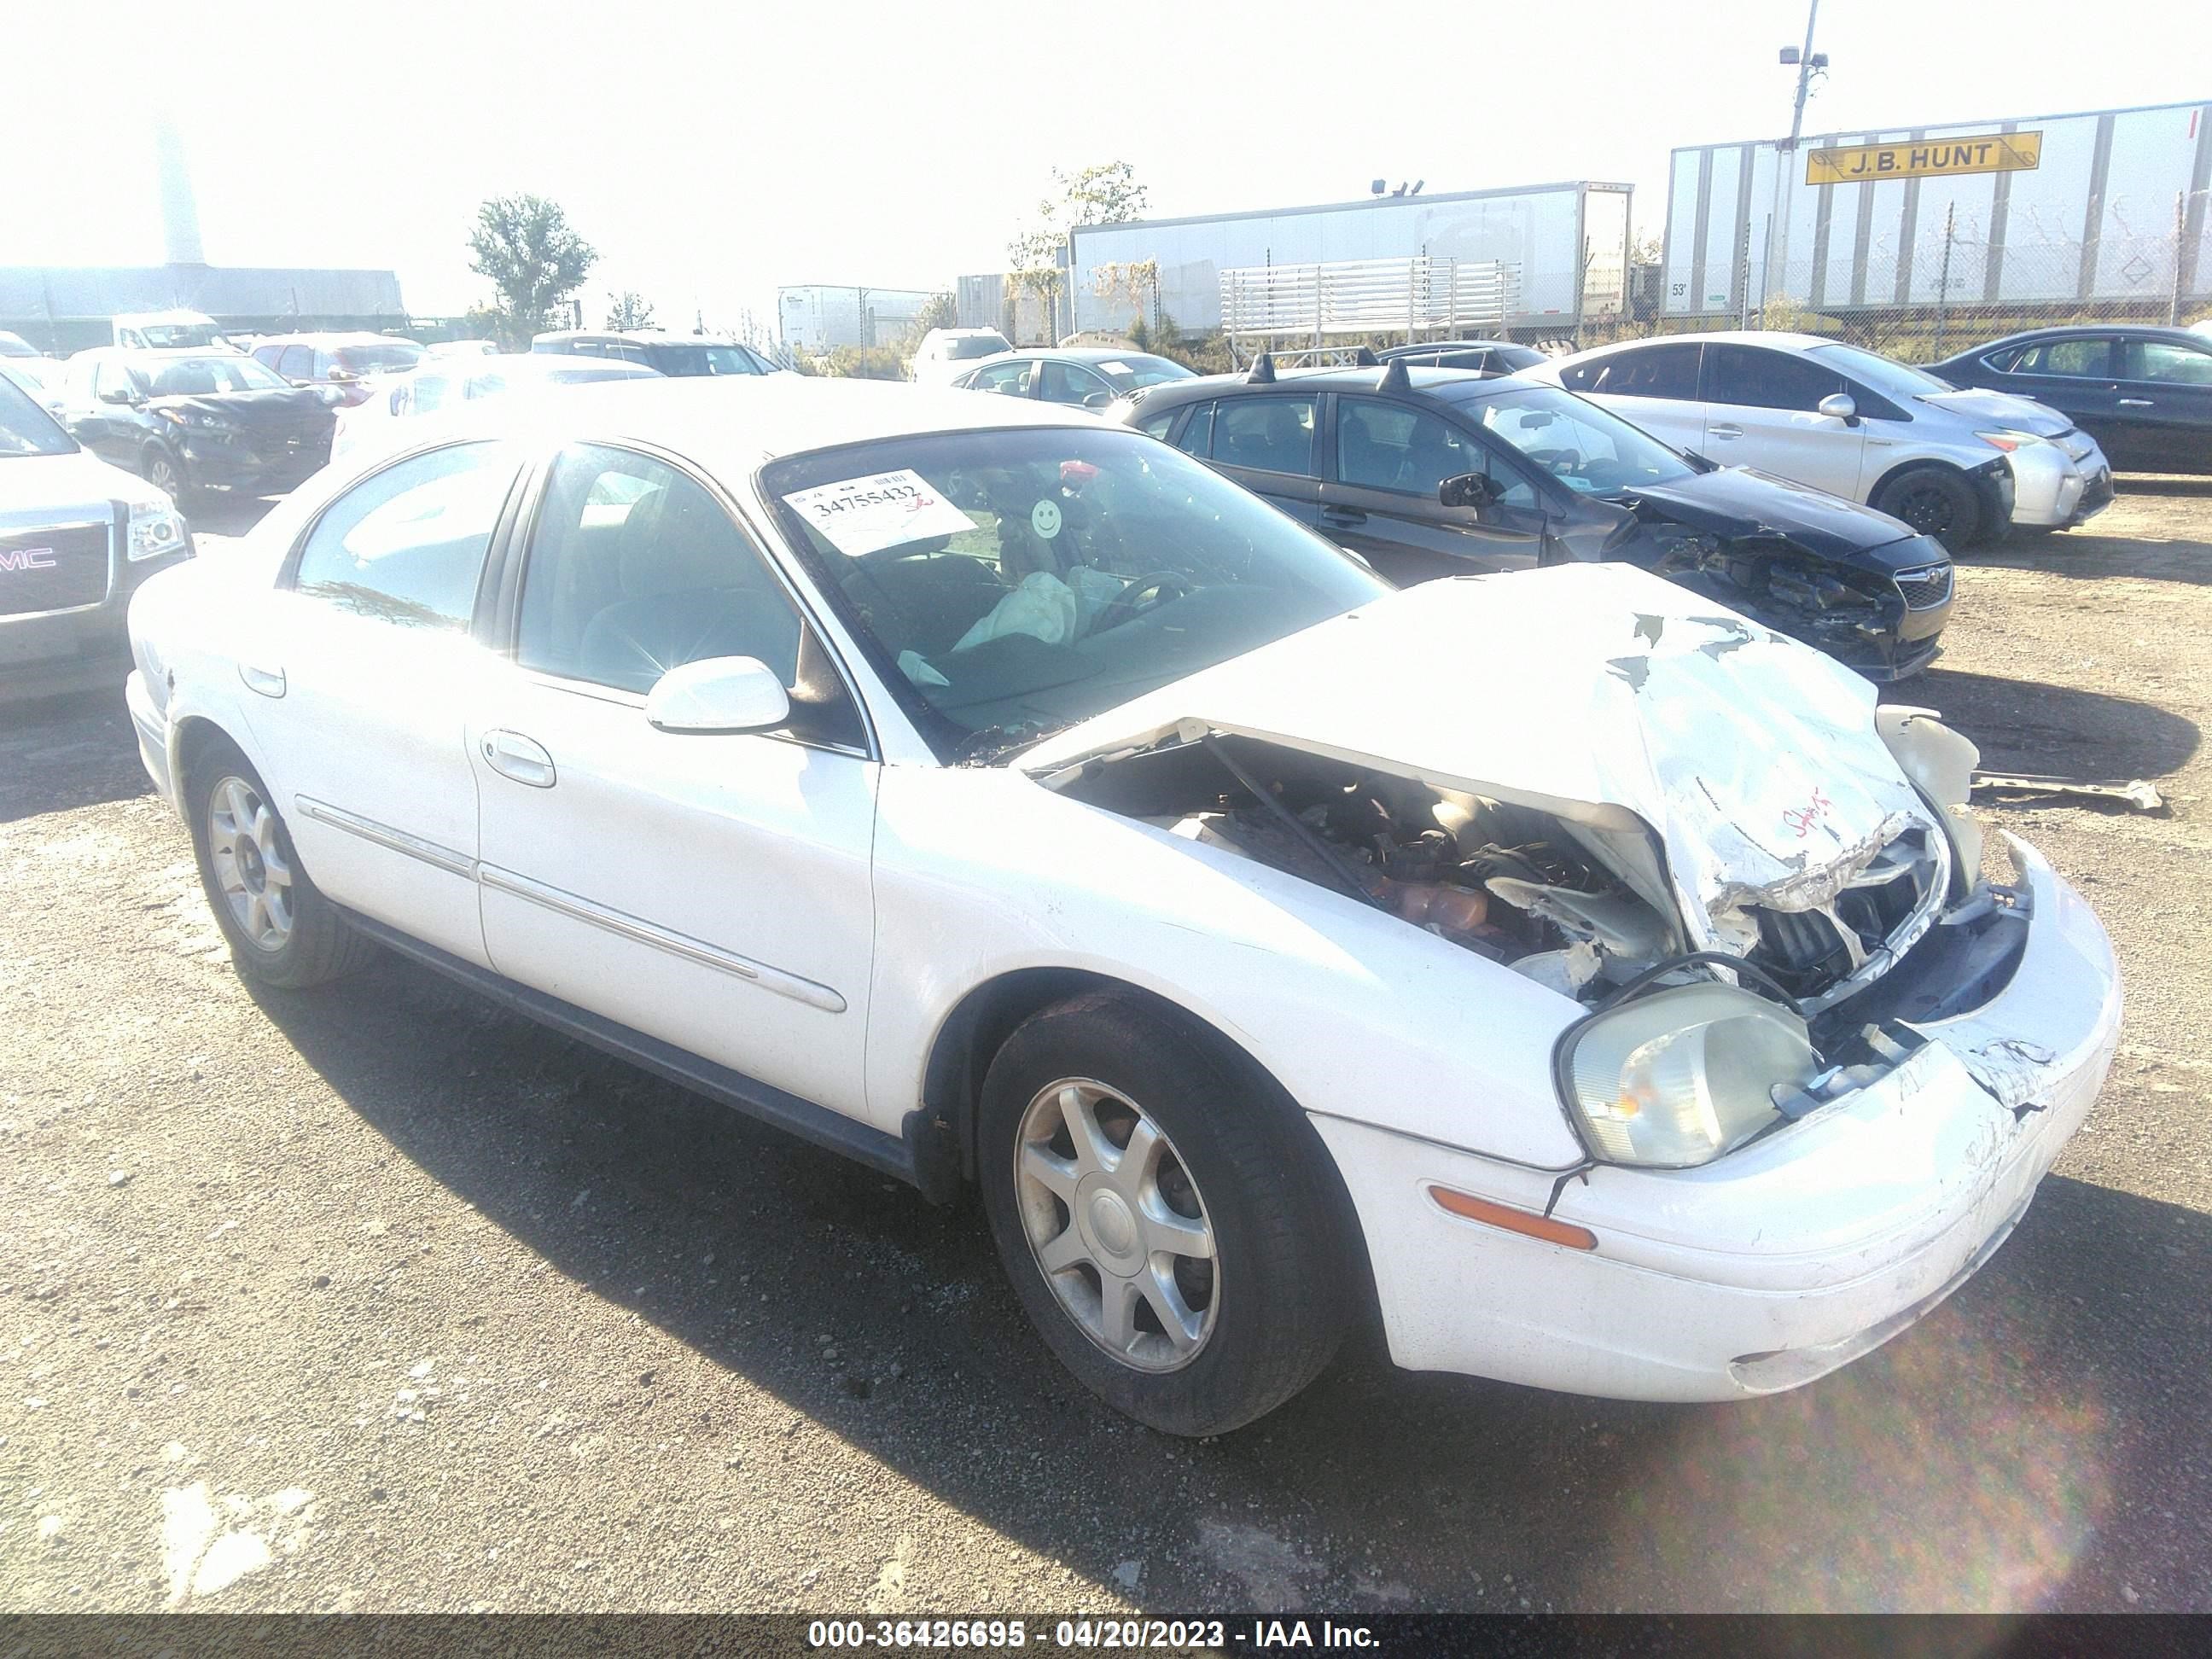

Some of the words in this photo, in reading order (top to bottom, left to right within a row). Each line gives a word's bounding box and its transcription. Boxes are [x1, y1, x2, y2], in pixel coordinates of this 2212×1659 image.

[1909, 143, 1994, 170] HUNT
[1672, 282, 1687, 296] 53'
[813, 485, 921, 517] 34755432
[0, 547, 56, 572] MC
